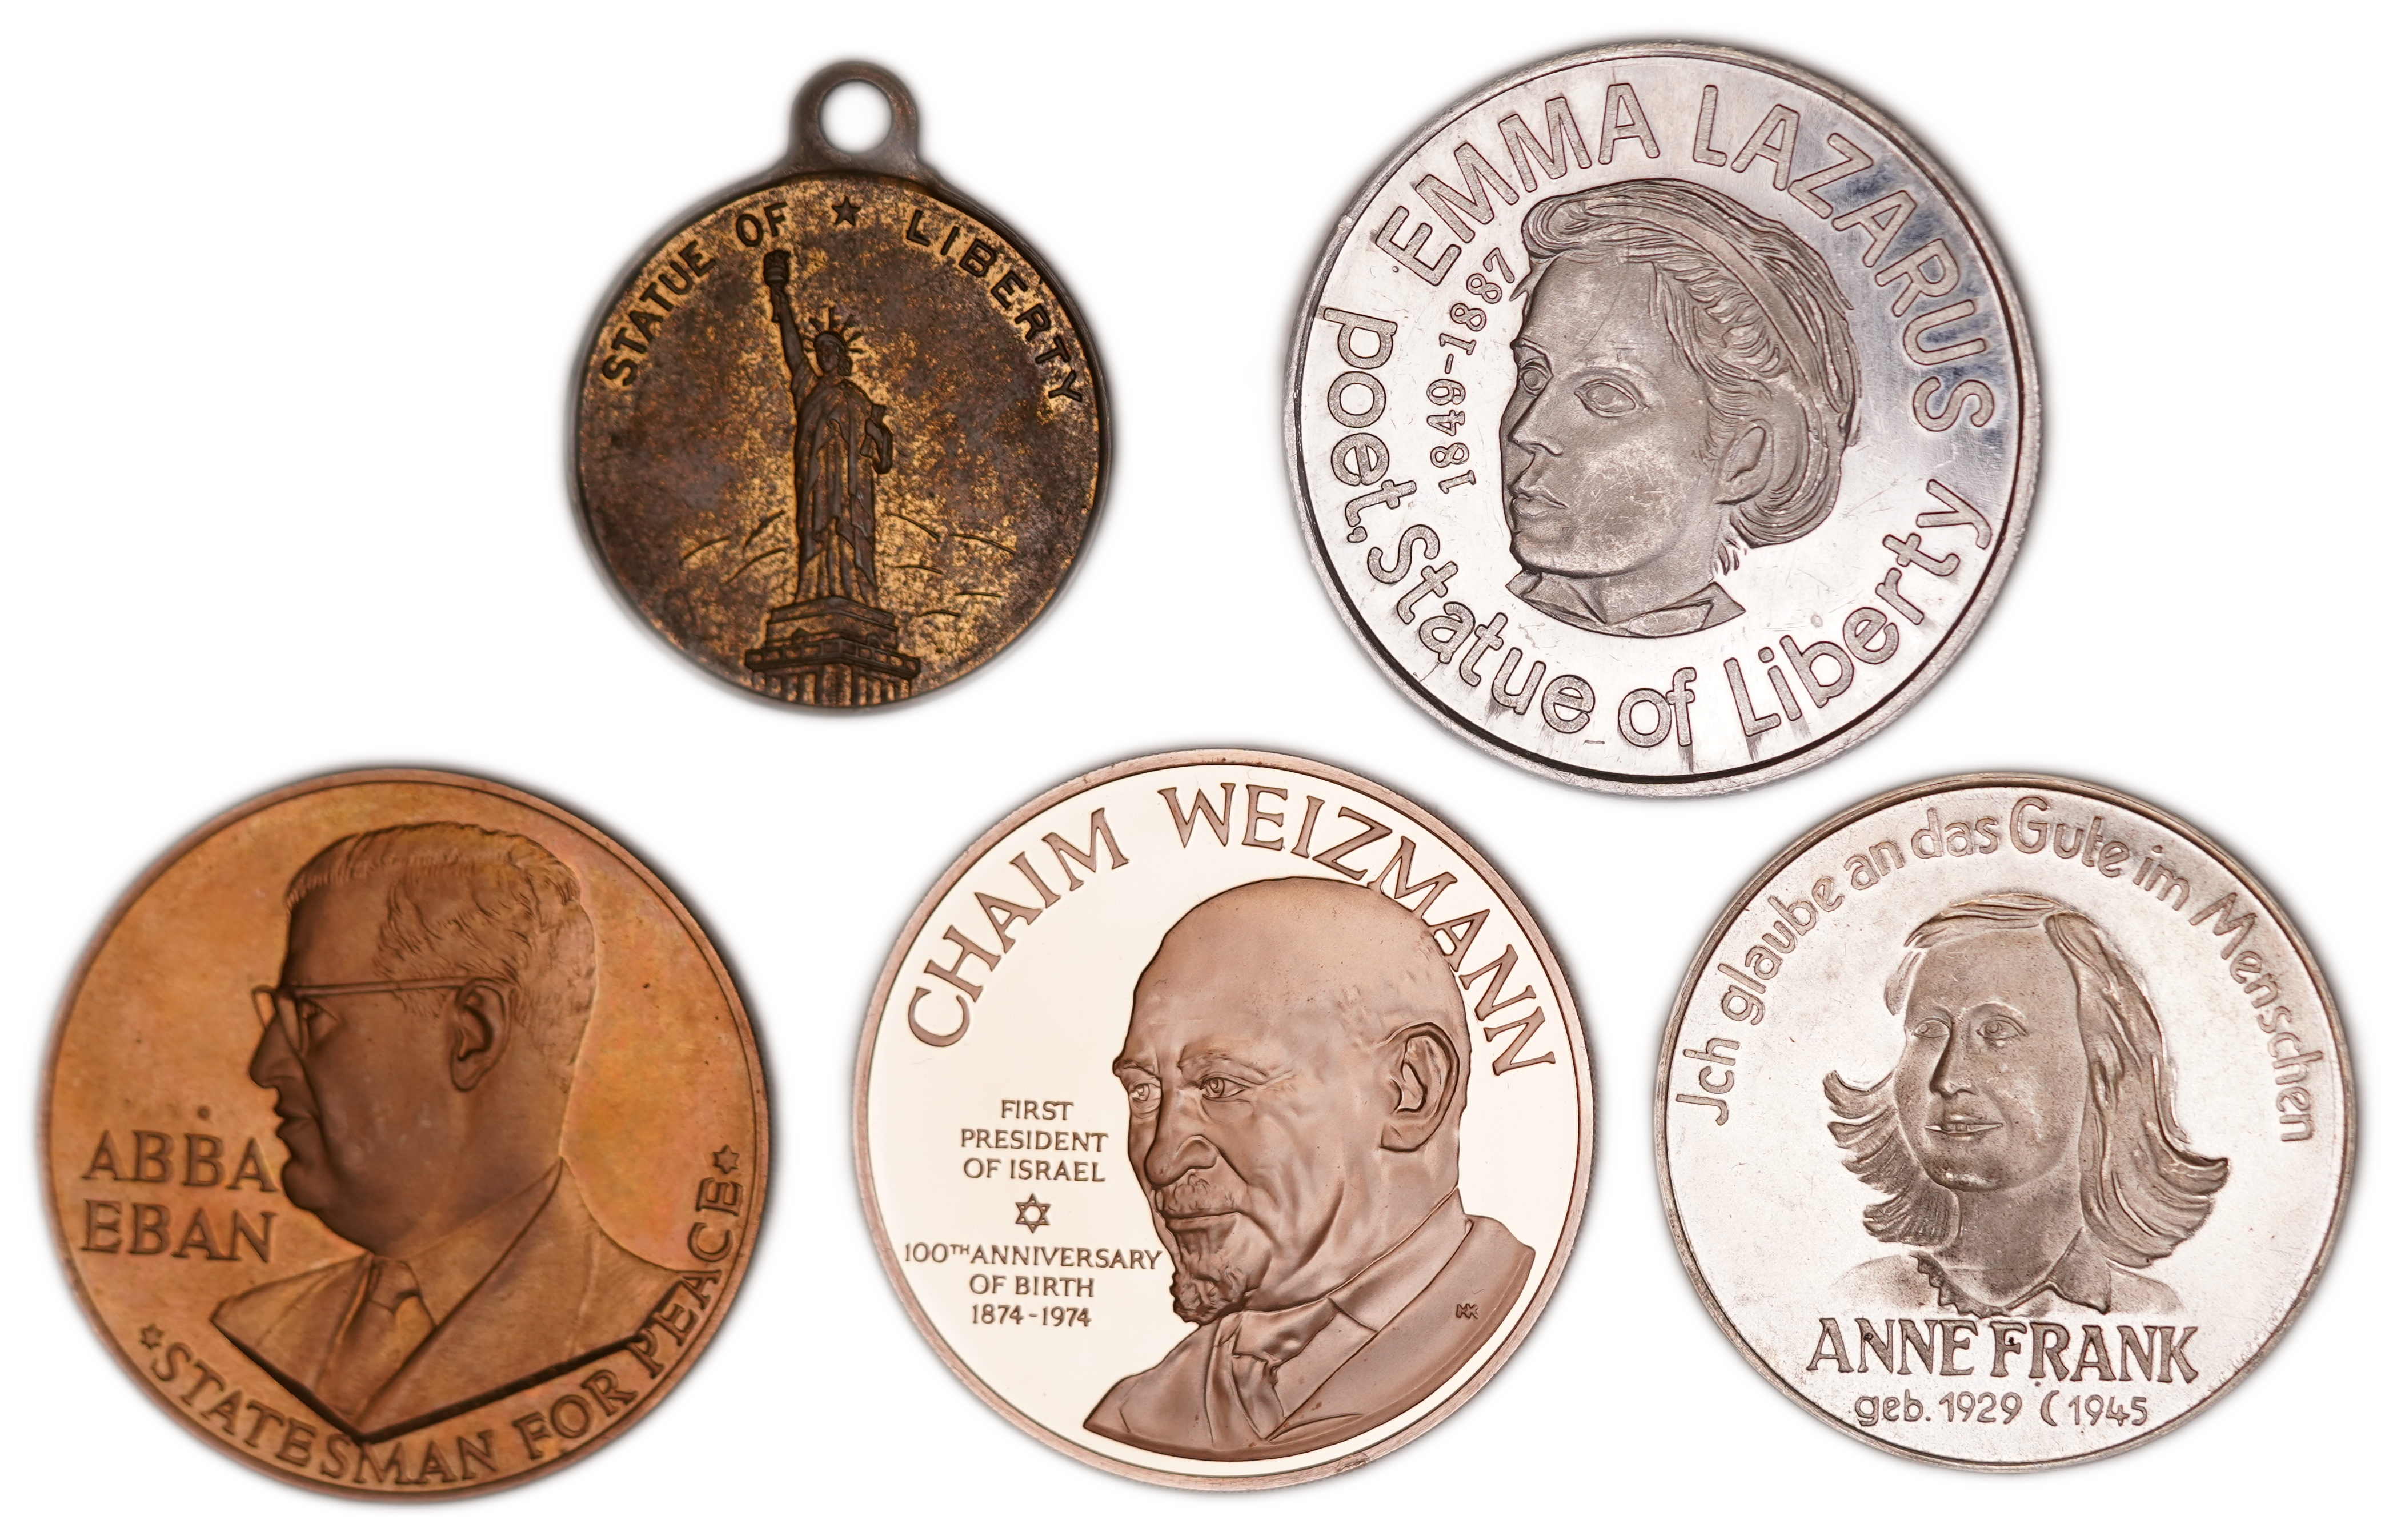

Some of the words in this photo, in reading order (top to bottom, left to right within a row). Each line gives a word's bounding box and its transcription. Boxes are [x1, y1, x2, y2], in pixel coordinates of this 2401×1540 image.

[1375, 83, 1660, 286] EMMA
[1693, 85, 1994, 431] LAZARUS
[602, 239, 716, 387] STATUE
[735, 201, 789, 247] OF
[906, 209, 1083, 403] LIBERTY
[1427, 247, 1515, 494] 1849-1887
[1368, 524, 1596, 733] Statue
[1618, 667, 1697, 747] of
[1724, 479, 1992, 736] Liberty
[908, 807, 1130, 1047] CHAIM
[1157, 783, 1556, 1076] WEIZMANN
[1718, 877, 1845, 1025] glaube
[1844, 840, 1905, 890] an
[1911, 808, 2001, 859] das
[2010, 796, 2130, 878] Gute
[2133, 845, 2190, 911] im
[2189, 892, 2324, 1142] Menschen
[961, 1128, 1109, 1152] PRESIDENT
[1001, 1100, 1074, 1120] FIRST
[81, 1129, 279, 1192] ABBA
[963, 1157, 1001, 1178] OF
[1011, 1159, 1106, 1182] ISRAEL
[81, 1200, 278, 1263] EBAN
[970, 1244, 1163, 1269] ANNIVERSARY
[969, 1273, 1007, 1294] OF
[1015, 1276, 1095, 1297] BIRTH
[151, 1342, 498, 1485] STATESMAN
[513, 1369, 638, 1460] FOR
[628, 1177, 743, 1379] PEACE
[1806, 1318, 1978, 1376] ANNE
[1990, 1321, 2199, 1383] FRANK
[1854, 1389, 1931, 1426] geb.
[1939, 1391, 2022, 1423] 1929
[2068, 1394, 2148, 1426] 1945
